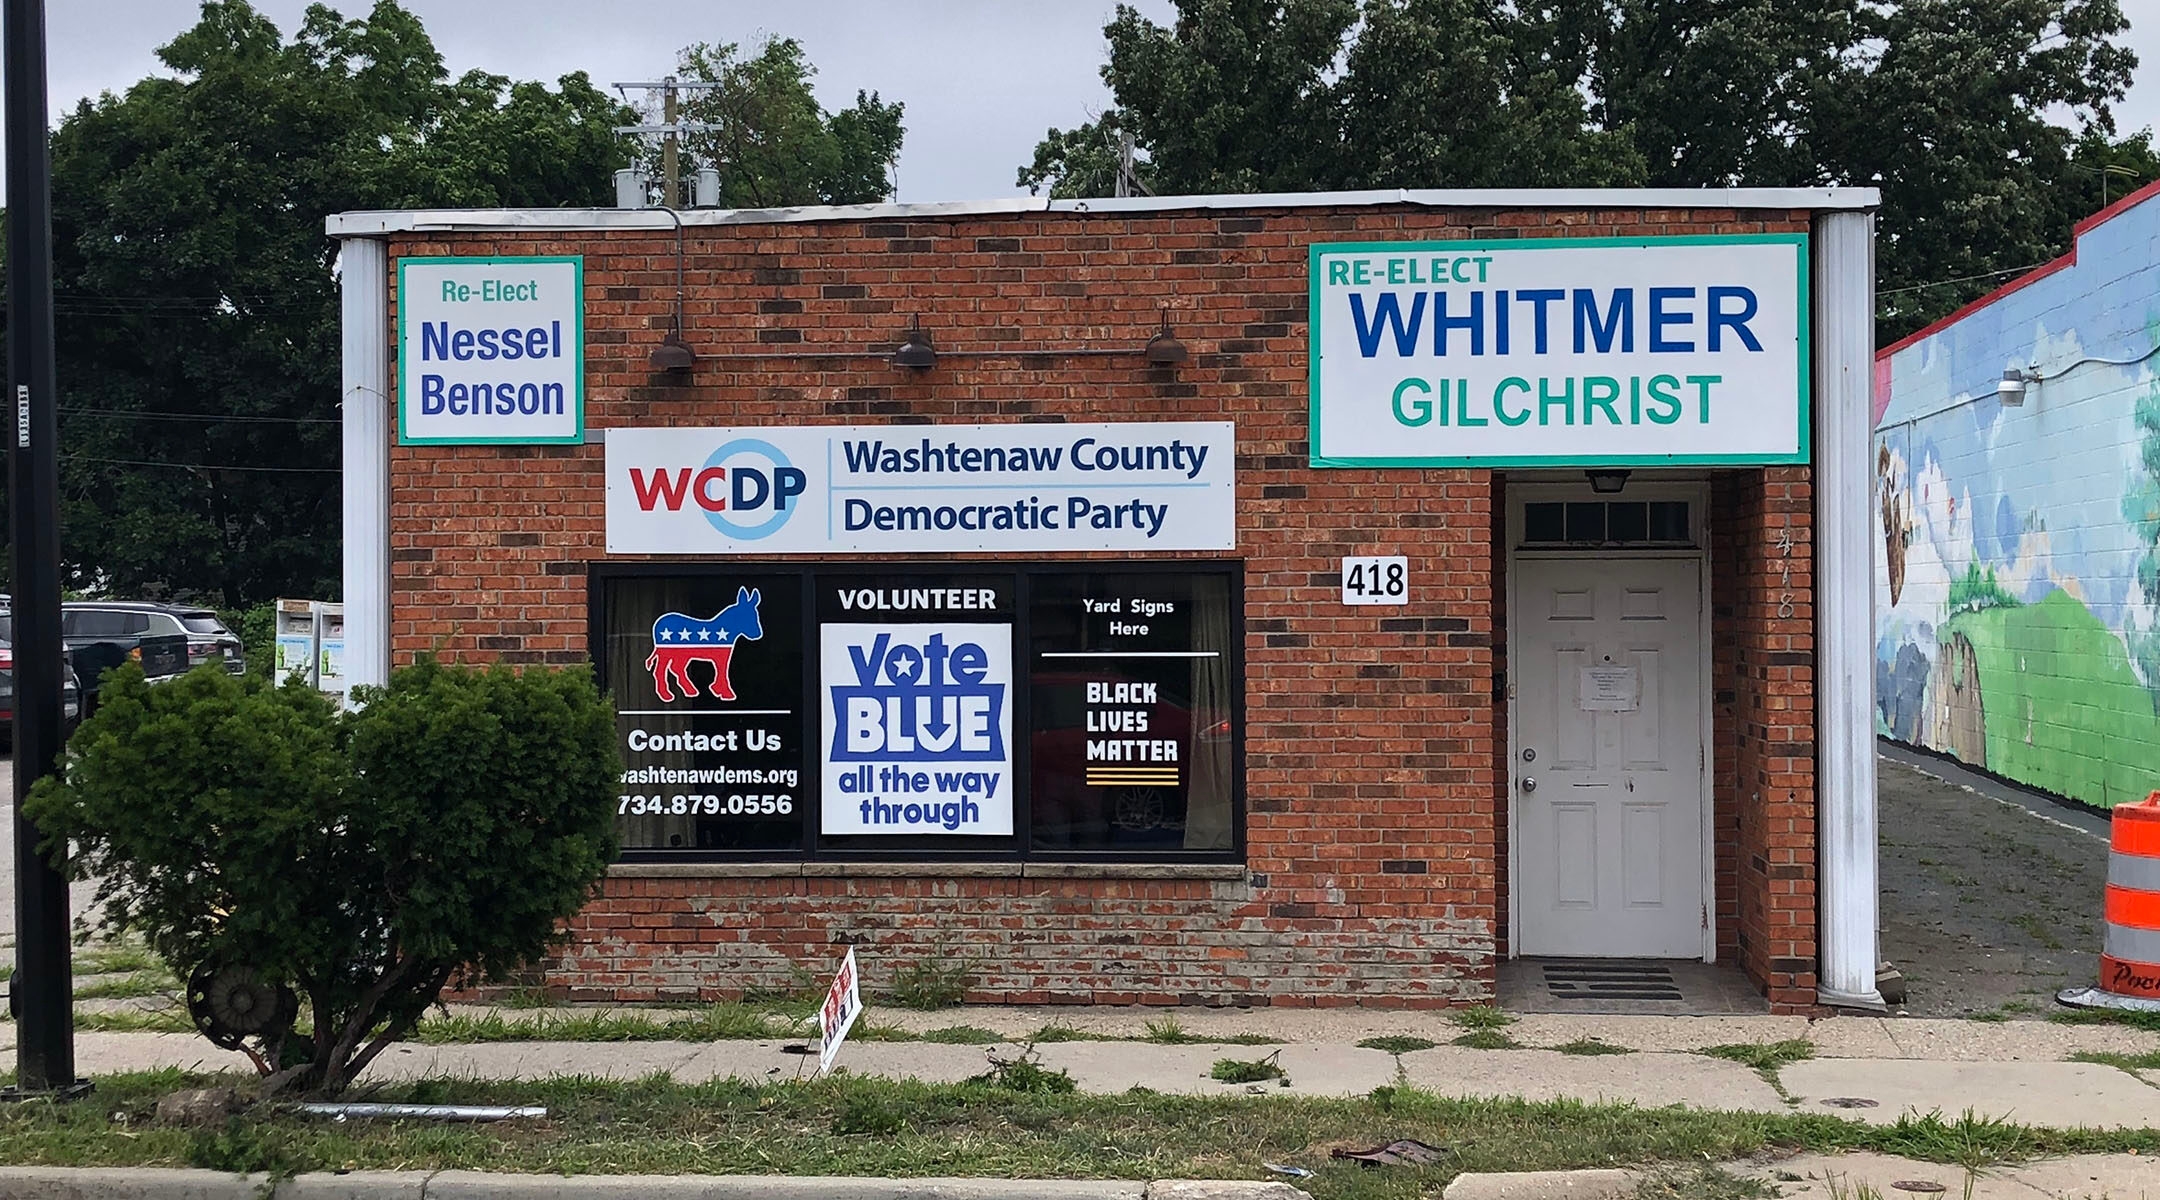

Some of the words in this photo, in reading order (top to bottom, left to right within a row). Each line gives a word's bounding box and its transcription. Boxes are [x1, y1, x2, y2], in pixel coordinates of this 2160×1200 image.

[1328, 256, 1493, 285] RE-ELECT
[442, 280, 538, 303] Re-Elect
[1348, 286, 1765, 358] WHITMER
[421, 320, 561, 361] Nessel
[421, 374, 564, 416] Benson
[1391, 374, 1723, 427] GILCHRIST
[843, 438, 1063, 474] Washtenaw
[1070, 437, 1209, 480] County
[628, 466, 807, 512] WCDP
[844, 495, 1058, 531] Democratic
[1067, 496, 1169, 539] Party
[1346, 563, 1404, 597] 418
[837, 588, 997, 610] VOLUNTEER
[1082, 598, 1121, 613] Yard
[1130, 598, 1174, 618] Signs
[1109, 621, 1149, 636] Here
[847, 632, 988, 686] Vote
[1086, 682, 1157, 704] BLACK
[847, 695, 991, 753] BLUE
[1086, 710, 1148, 732] LIVES
[627, 729, 738, 752] Contact
[746, 729, 782, 752] Us
[1086, 739, 1178, 762] MATTER
[838, 764, 874, 793] all
[879, 764, 930, 793] the
[934, 771, 1001, 800] way
[617, 794, 793, 815] 734.879.0556
[859, 794, 979, 831] through
